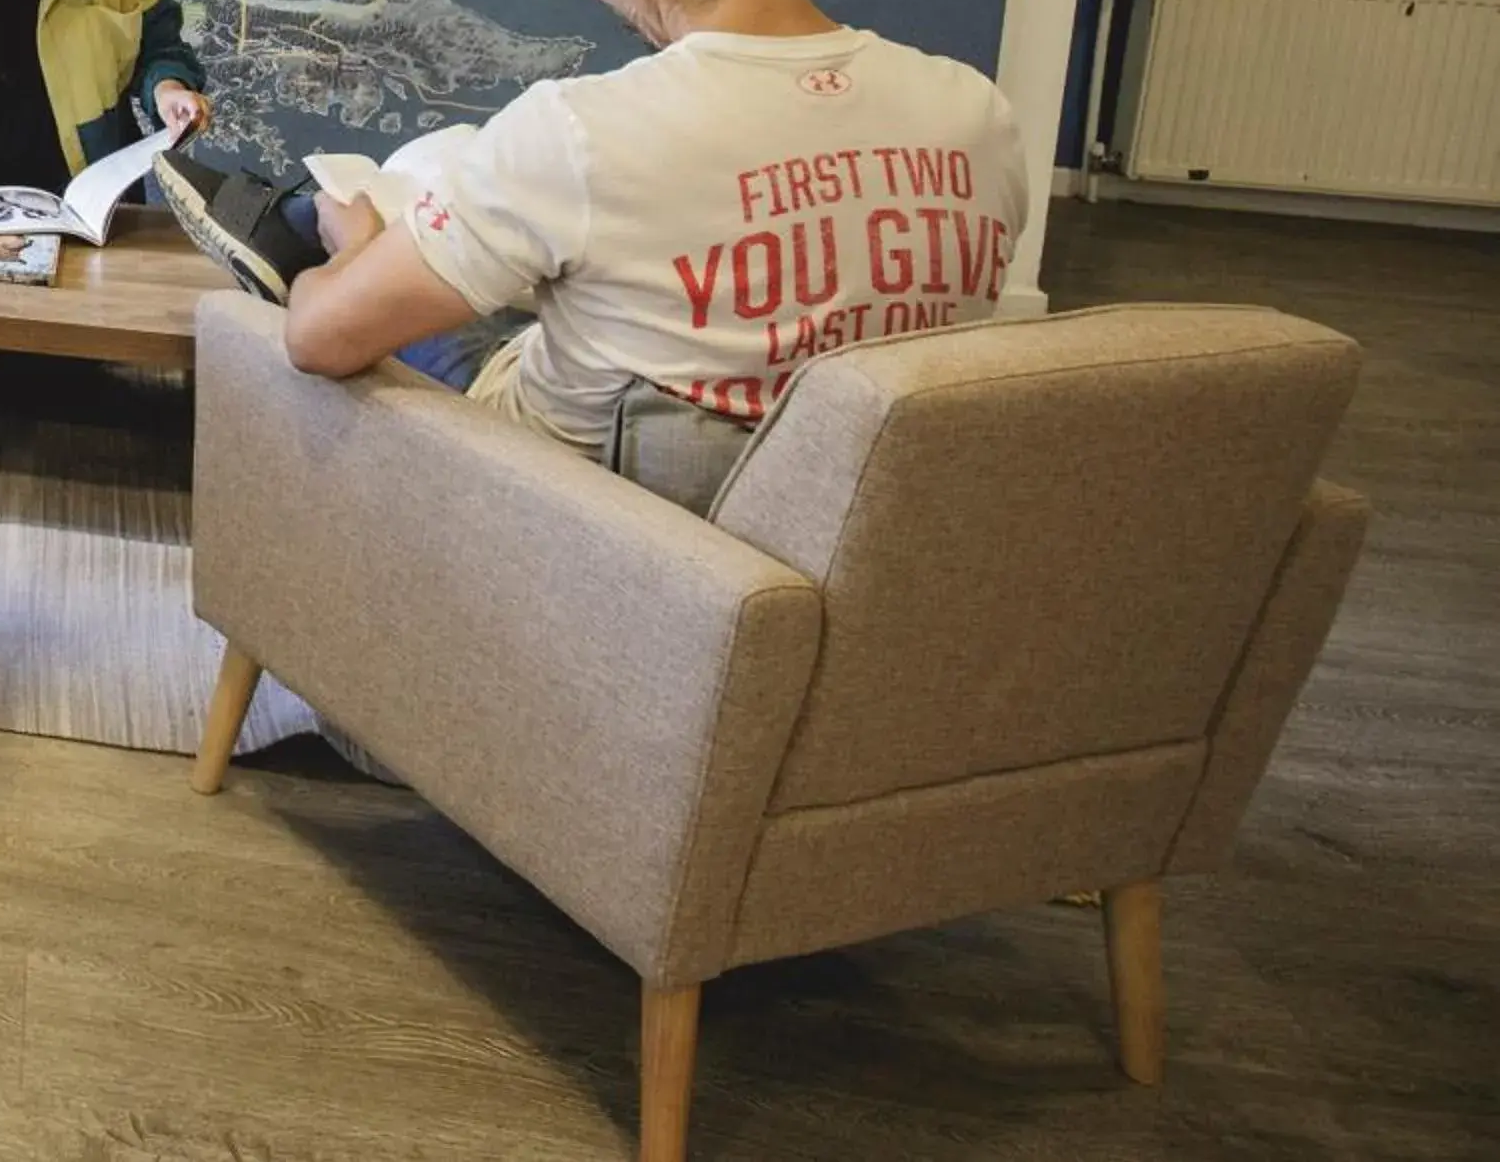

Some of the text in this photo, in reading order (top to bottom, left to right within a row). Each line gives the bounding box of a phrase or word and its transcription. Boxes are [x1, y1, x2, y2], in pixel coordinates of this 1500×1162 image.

[737, 148, 973, 223] FIRST TWO
[673, 216, 839, 329] YOU
[766, 303, 873, 367] LAST
